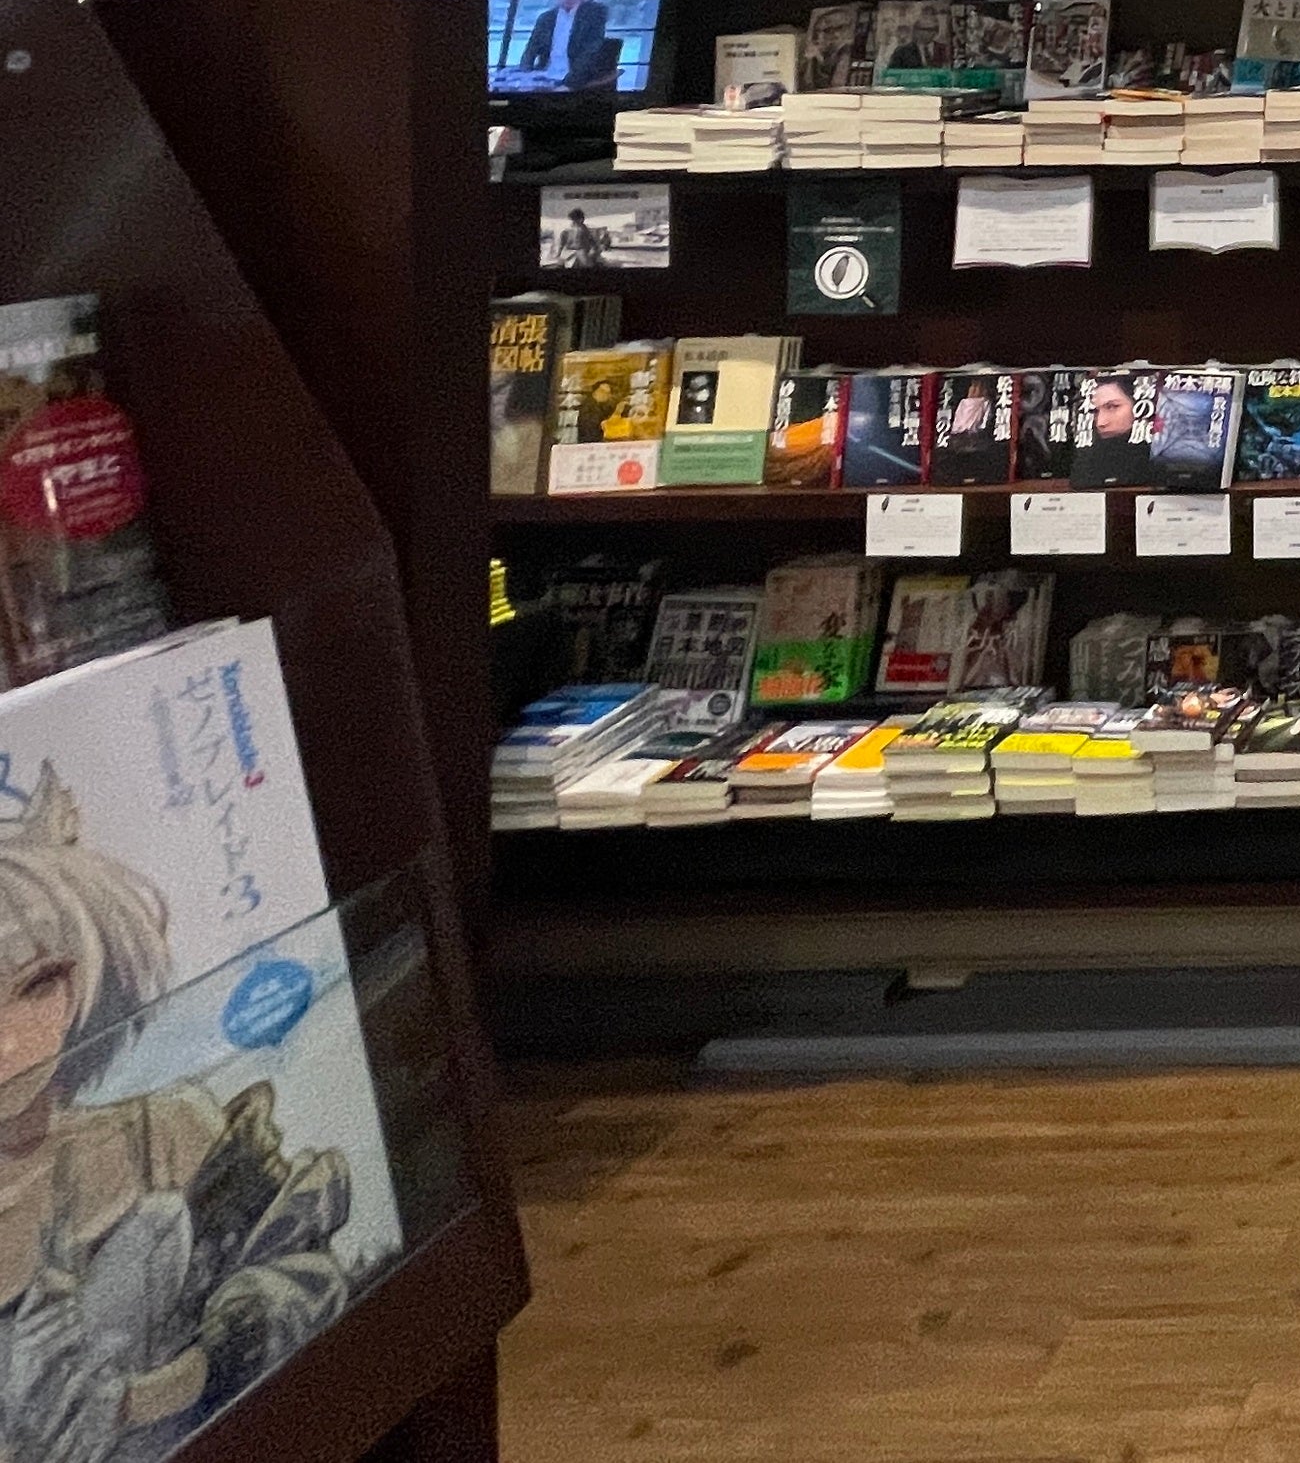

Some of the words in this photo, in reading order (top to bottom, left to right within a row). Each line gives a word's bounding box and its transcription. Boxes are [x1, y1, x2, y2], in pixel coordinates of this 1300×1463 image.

[1164, 373, 1233, 395] 松本清張
[1127, 375, 1157, 445] 霧の旗
